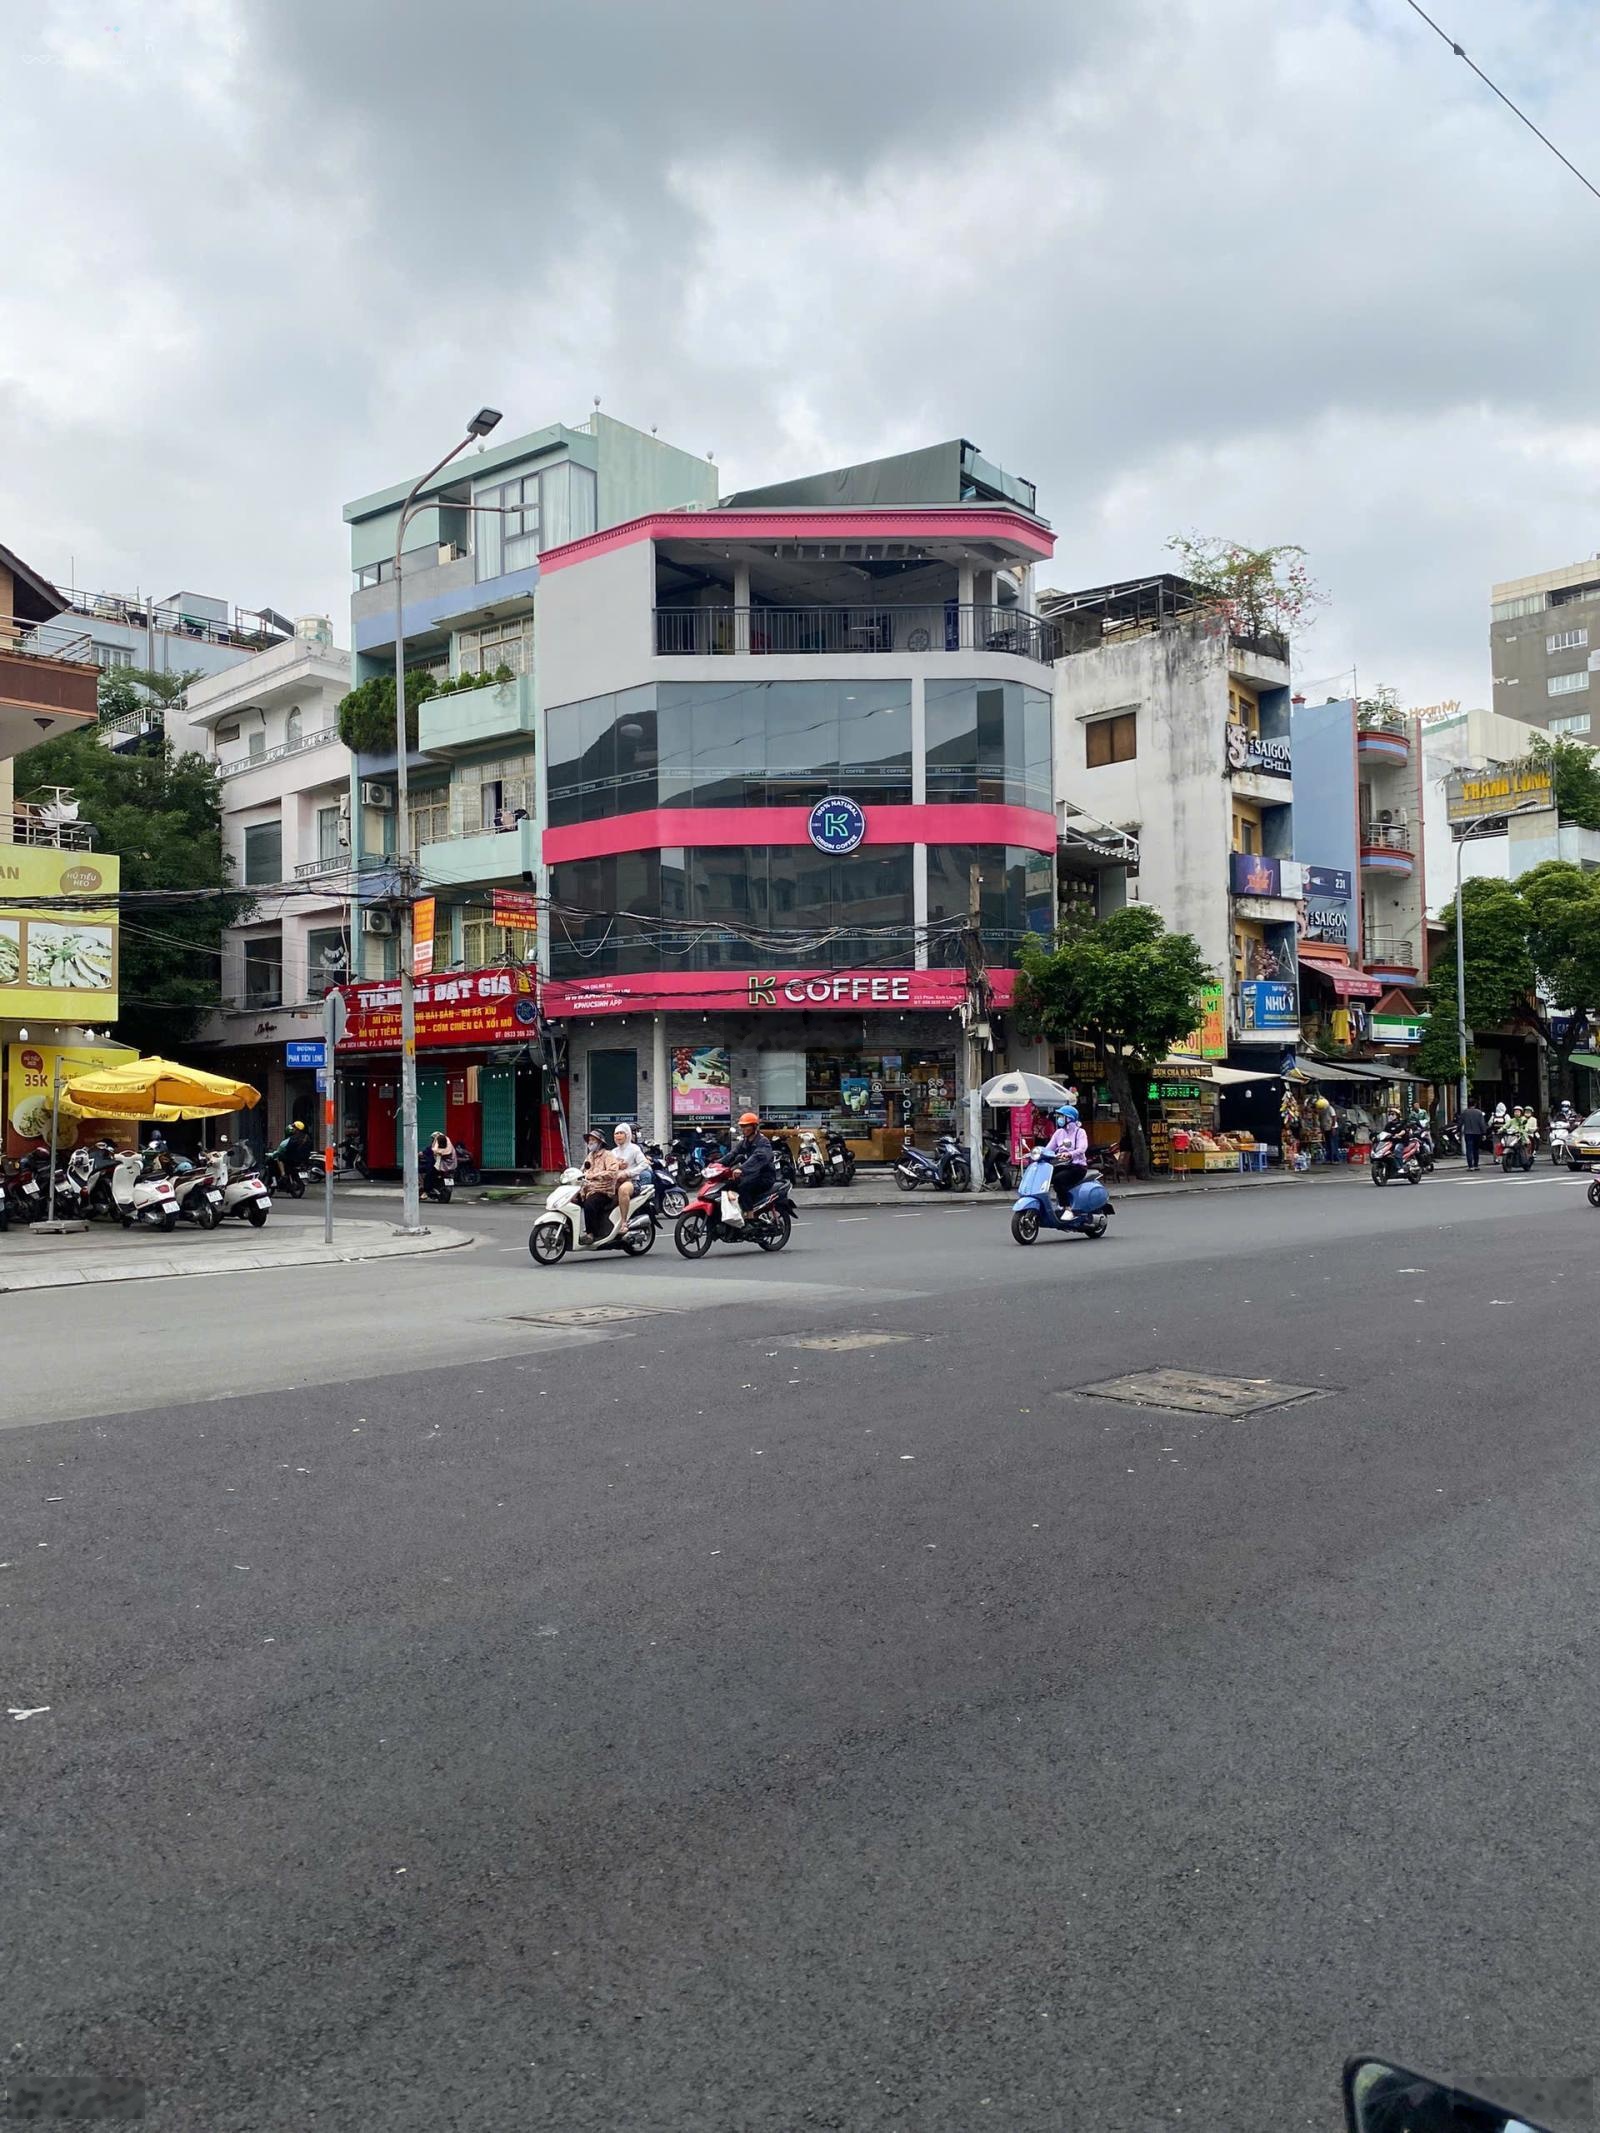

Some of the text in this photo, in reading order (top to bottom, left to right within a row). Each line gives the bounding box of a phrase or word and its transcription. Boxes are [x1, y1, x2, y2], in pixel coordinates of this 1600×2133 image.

[1254, 740, 1291, 760] SAIGON
[1264, 758, 1292, 772] CHILL
[816, 803, 830, 816] 100%
[831, 800, 858, 817] NATURAL
[836, 834, 858, 850] COFFEE
[1335, 878, 1346, 890] 231
[1314, 911, 1348, 928] SAIGON
[1323, 928, 1346, 938] CHILL
[478, 976, 512, 996] GIA
[748, 976, 910, 1005] K COFFEE
[1265, 994, 1286, 1011] NHƯ
[312, 1054, 323, 1062] LONG
[24, 1074, 48, 1087] 35K
